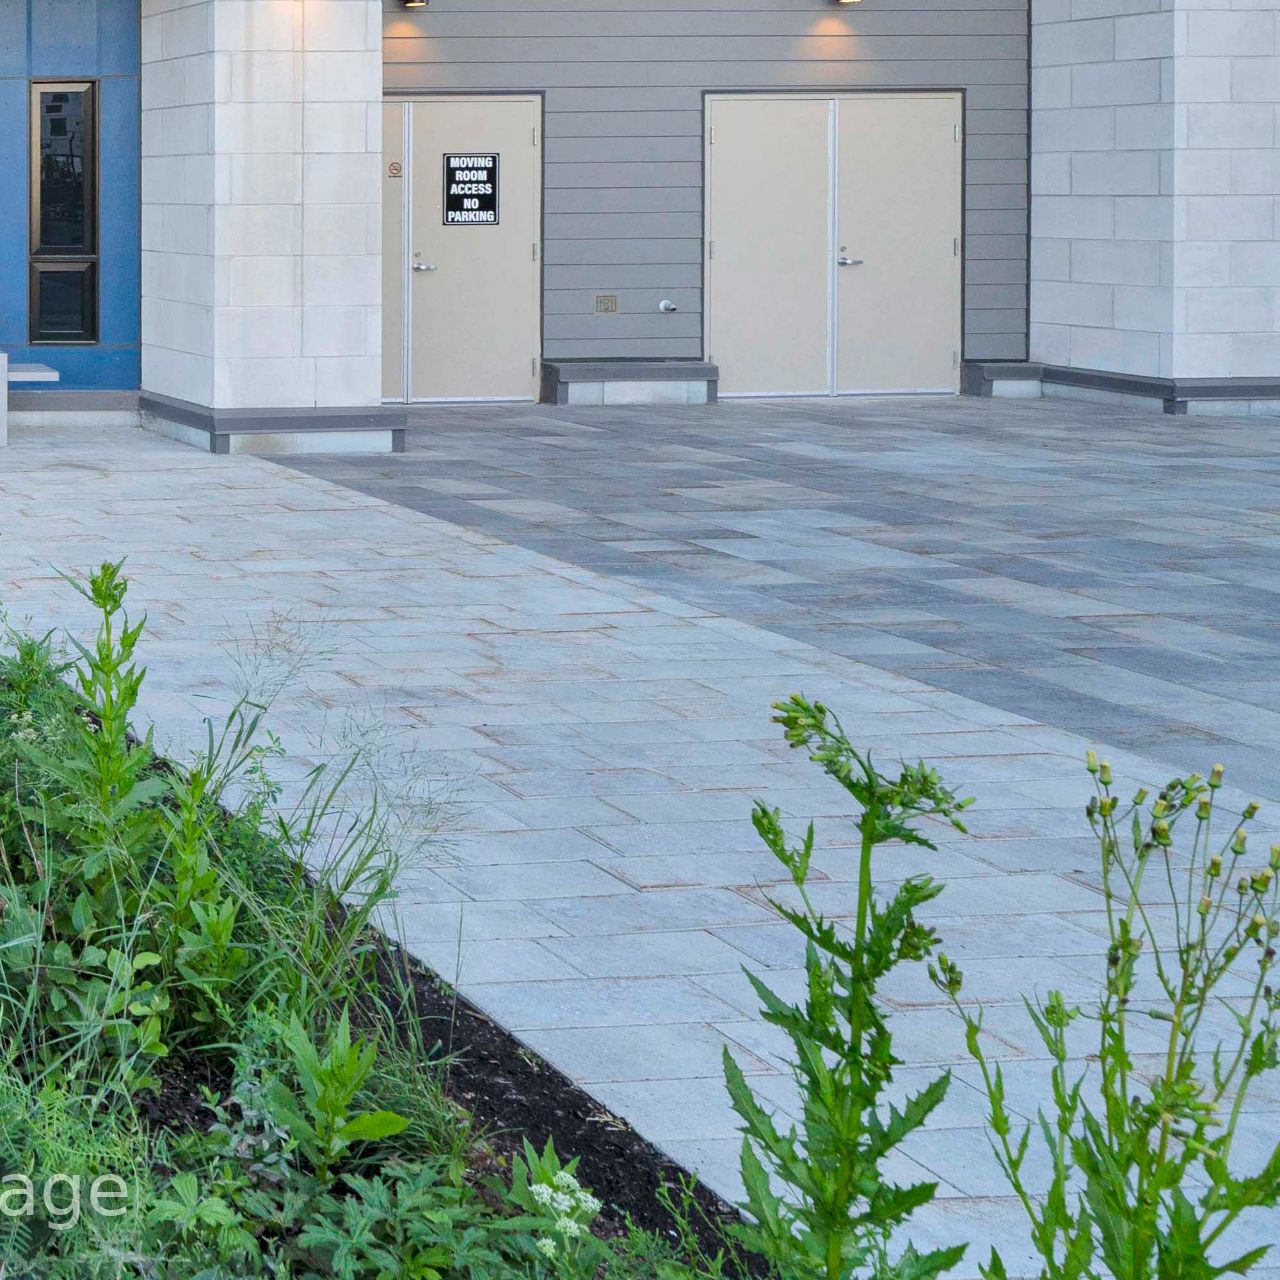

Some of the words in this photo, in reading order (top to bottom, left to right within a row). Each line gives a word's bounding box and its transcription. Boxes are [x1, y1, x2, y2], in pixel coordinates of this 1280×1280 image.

[450, 157, 493, 168] MOVING
[455, 170, 488, 181] ROOM
[450, 184, 493, 195] ACCESS
[463, 198, 480, 209] NO
[447, 211, 495, 222] PARKING
